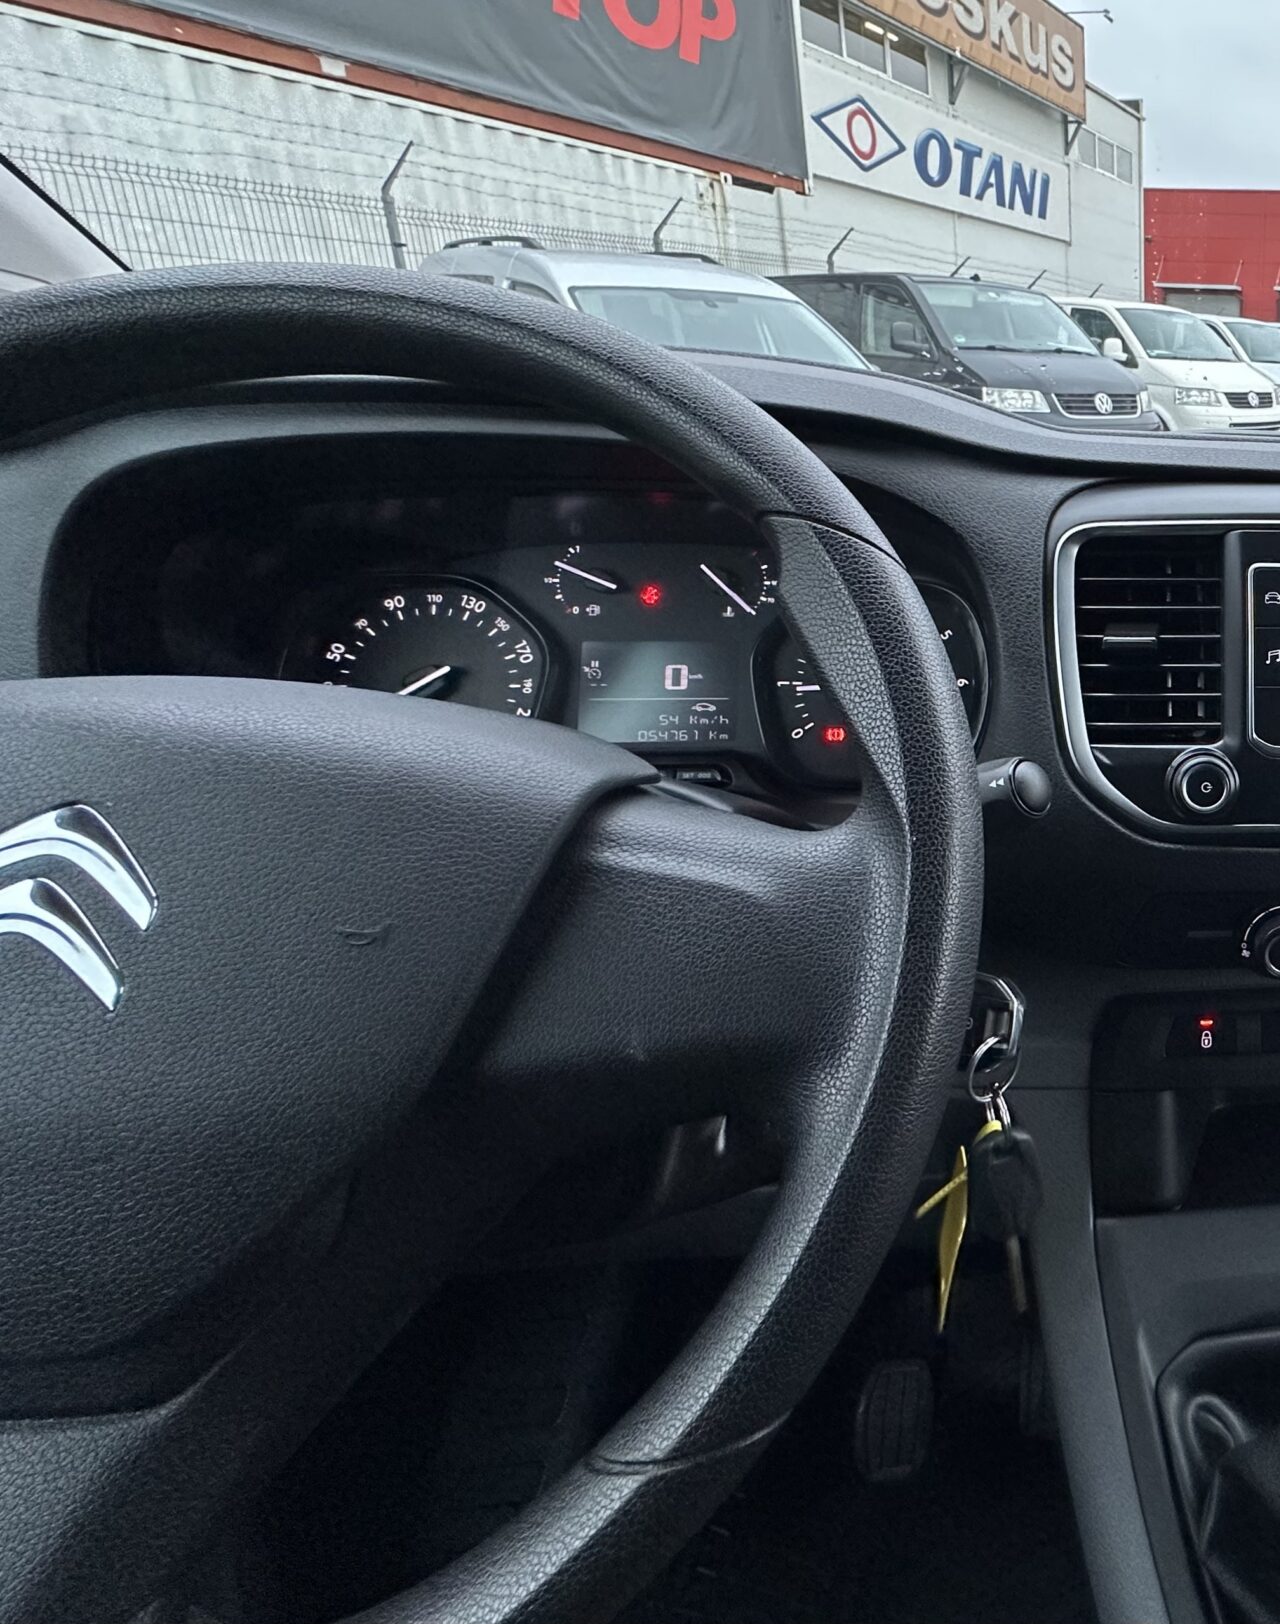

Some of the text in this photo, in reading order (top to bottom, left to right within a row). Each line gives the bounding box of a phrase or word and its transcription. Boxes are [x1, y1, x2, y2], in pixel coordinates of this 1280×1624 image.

[914, 128, 1050, 220] OTANI
[384, 596, 405, 611] 90
[427, 594, 443, 603] 110
[460, 595, 486, 613] 130
[494, 616, 510, 632] 150
[940, 629, 953, 640] 5
[326, 643, 346, 662] 50
[514, 639, 534, 664] 170
[664, 664, 688, 690] 0
[957, 678, 969, 687] 6
[522, 678, 532, 694] 190
[659, 714, 679, 725] 54
[637, 730, 699, 741] 054761
[791, 728, 804, 739] 0
